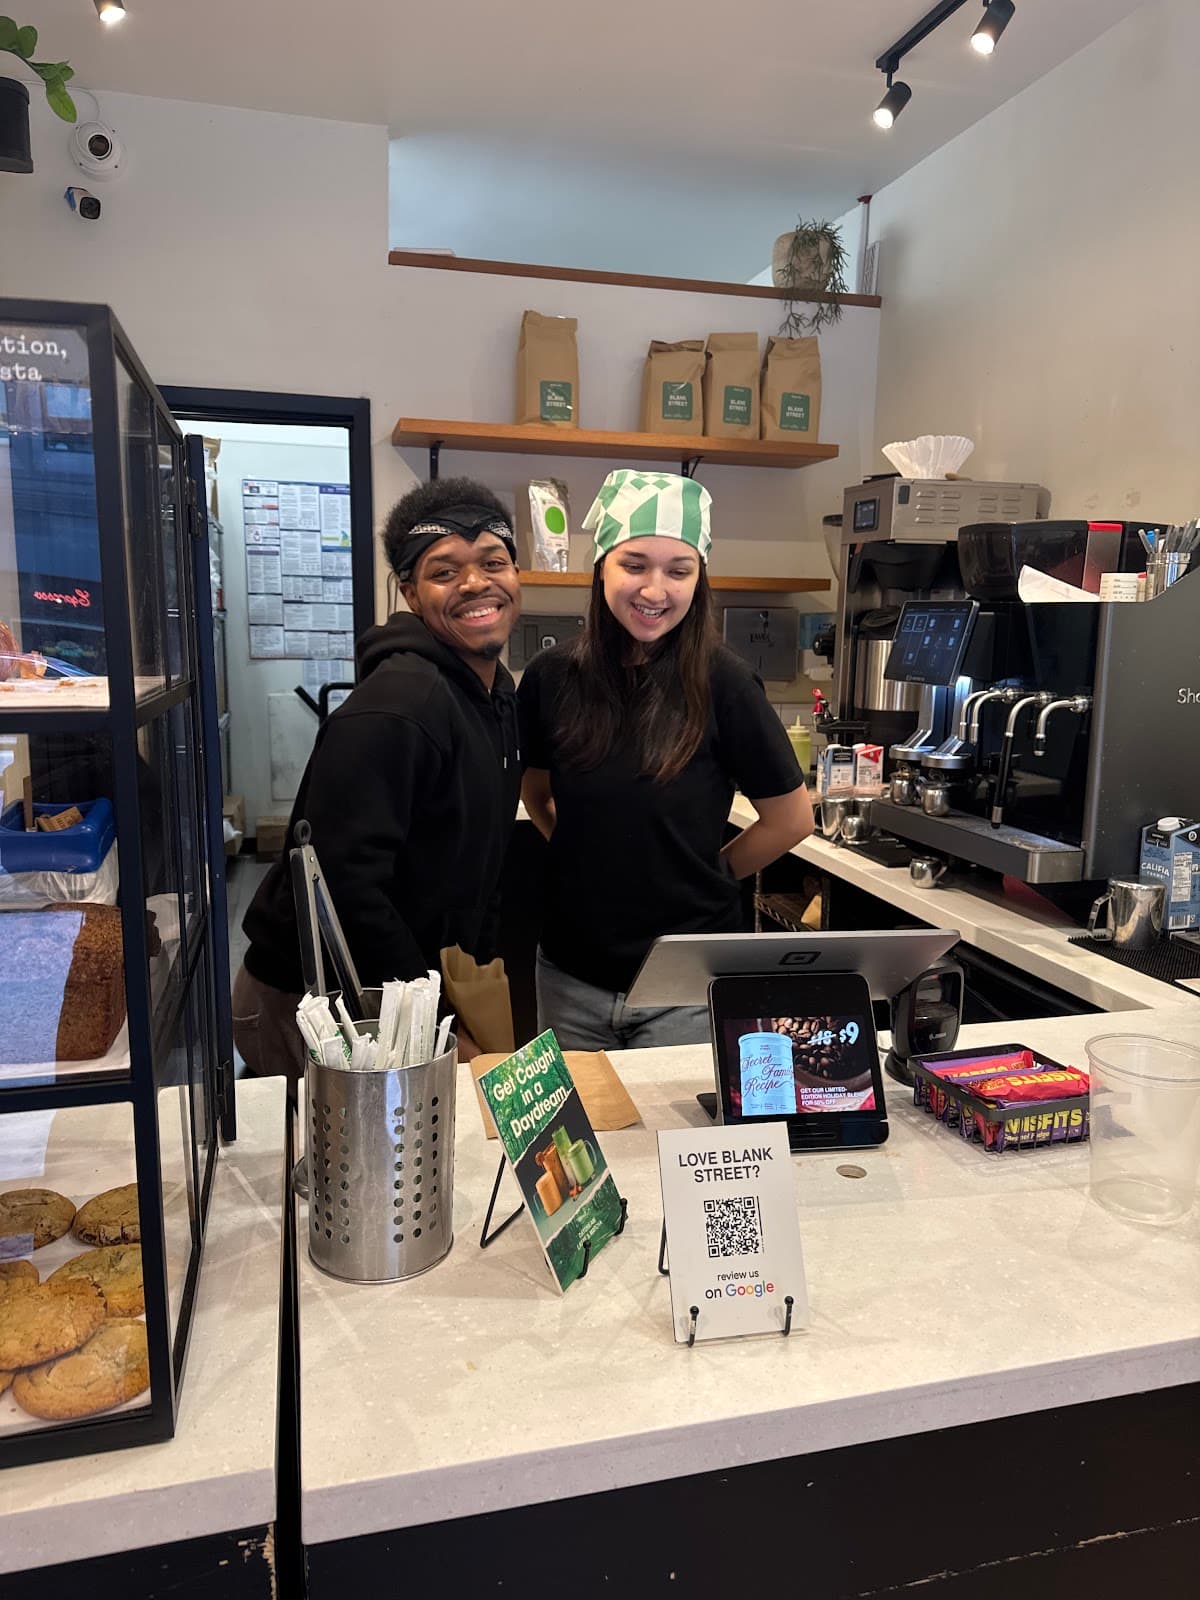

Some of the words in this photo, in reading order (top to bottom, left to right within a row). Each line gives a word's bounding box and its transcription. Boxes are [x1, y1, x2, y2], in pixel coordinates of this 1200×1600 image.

[0, 334, 67, 359] tion,
[1141, 862, 1170, 877] CALIFIA
[839, 1021, 860, 1045] $9
[493, 1075, 516, 1101] Get
[516, 1045, 556, 1085] Caught
[520, 1088, 534, 1106] in
[533, 1081, 544, 1097] a
[743, 1079, 791, 1098] Recipe
[678, 1151, 718, 1168] LOVE
[722, 1147, 774, 1164] BLANK
[694, 1165, 761, 1183] STREET?
[717, 1271, 747, 1282] review
[748, 1270, 760, 1279] us
[705, 1287, 722, 1300] on
[725, 1281, 775, 1298] Google
